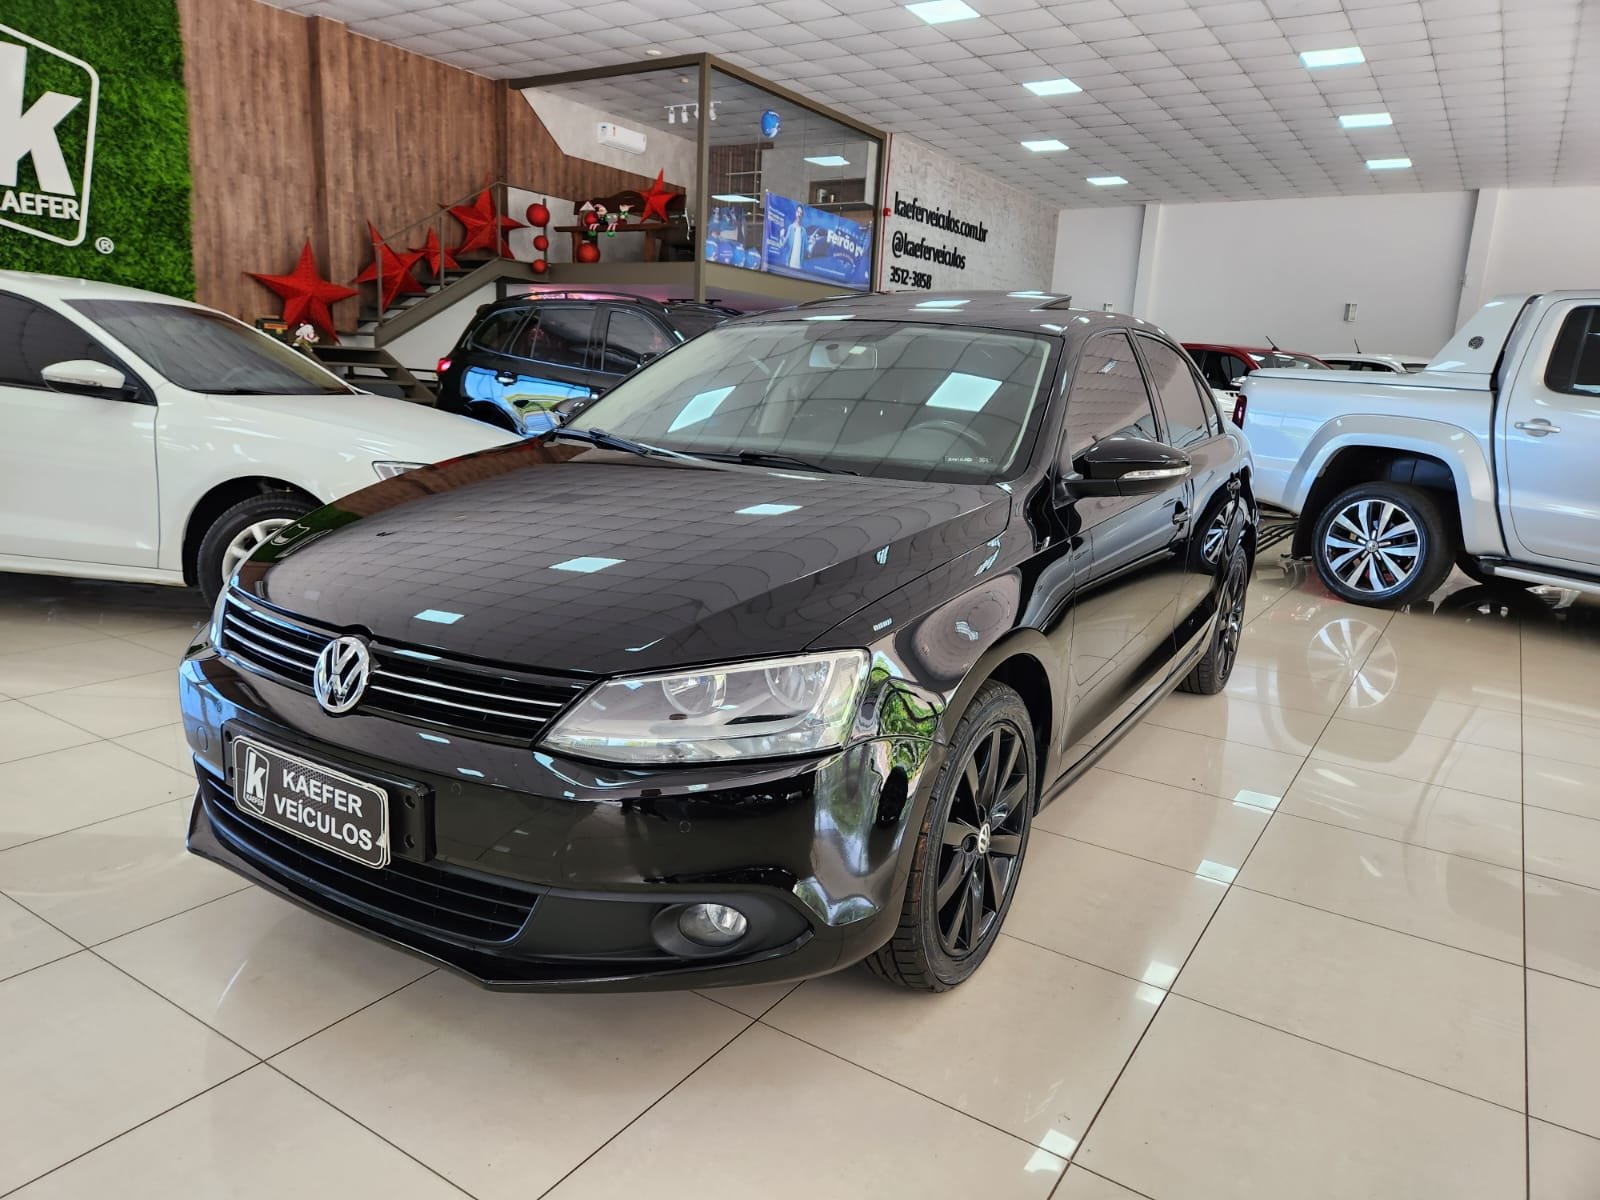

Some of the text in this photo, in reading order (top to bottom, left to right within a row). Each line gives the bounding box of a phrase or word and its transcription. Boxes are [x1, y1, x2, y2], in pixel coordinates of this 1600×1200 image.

[0, 189, 80, 221] AEFER
[894, 191, 988, 242] kaeferveiculos.com.br
[892, 231, 966, 270] @kaeferveiculos
[889, 265, 932, 290] 3512-3858
[282, 769, 363, 818] KAEFER
[273, 792, 373, 851] VEÍCULOS
